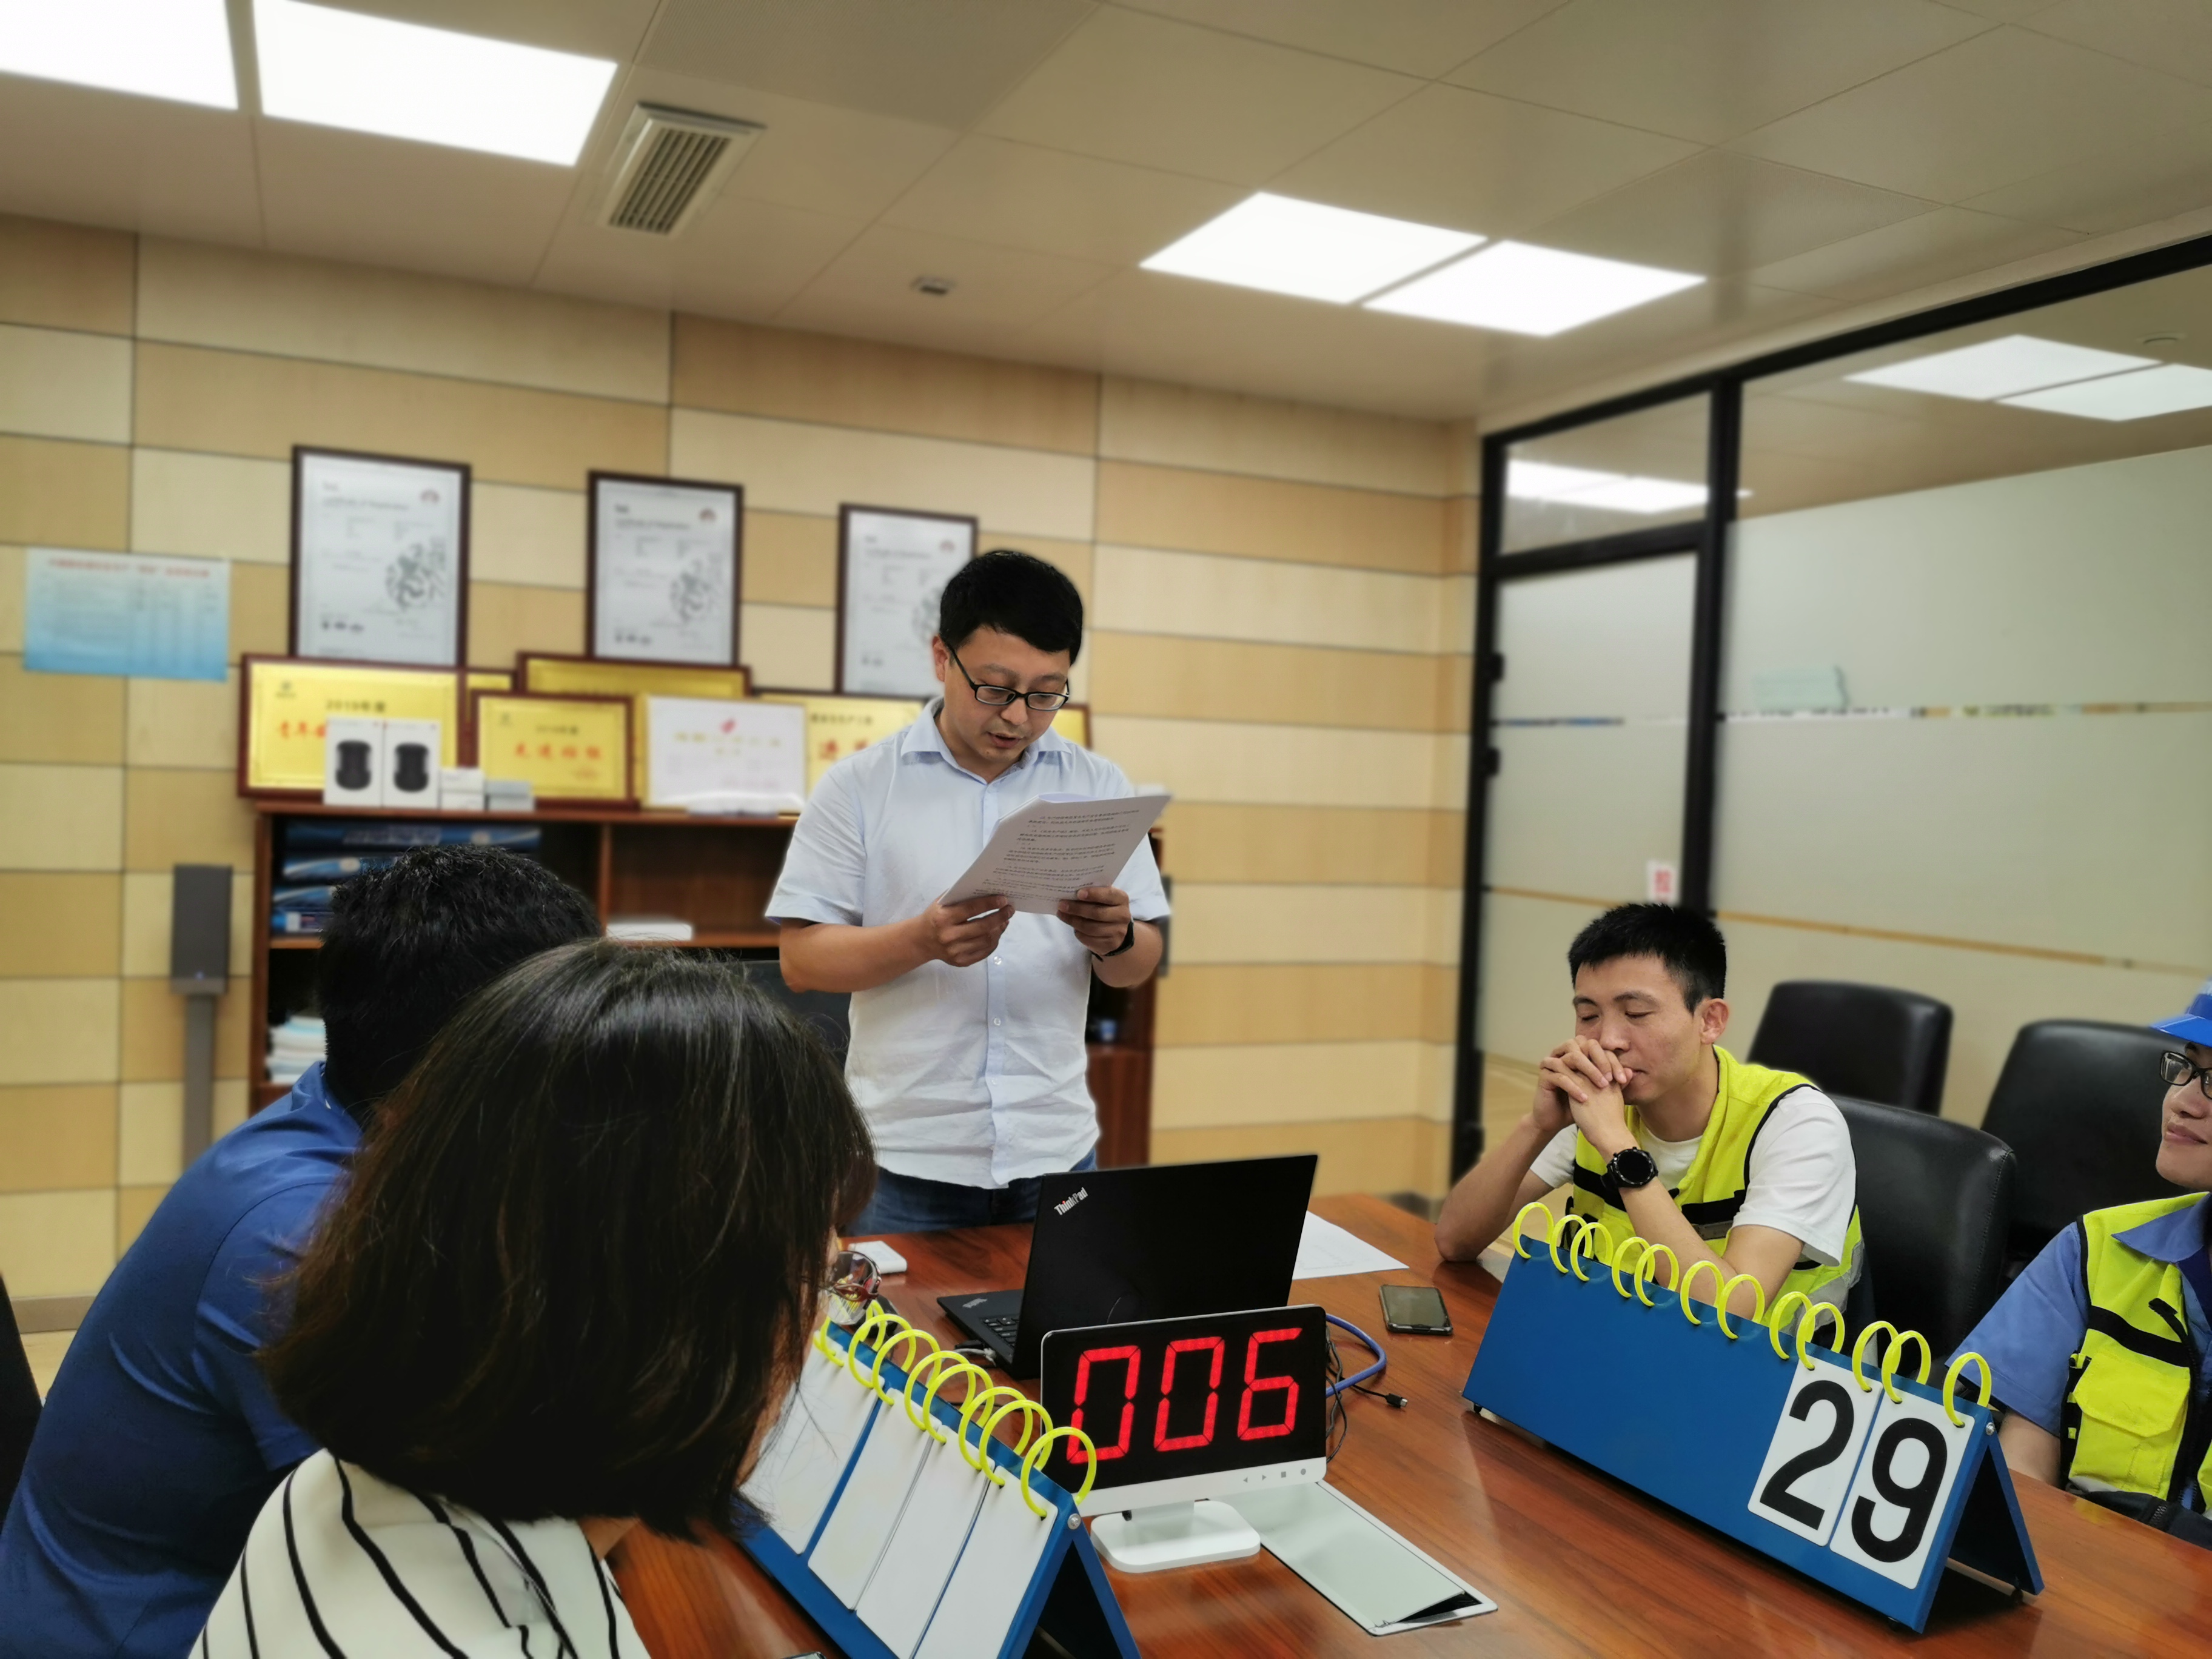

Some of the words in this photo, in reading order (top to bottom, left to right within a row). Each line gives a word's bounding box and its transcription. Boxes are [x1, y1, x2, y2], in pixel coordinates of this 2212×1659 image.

[1054, 1187, 1088, 1215] ThinkPad
[1067, 1328, 1302, 1464] 006
[1760, 1380, 1948, 1563] 29
